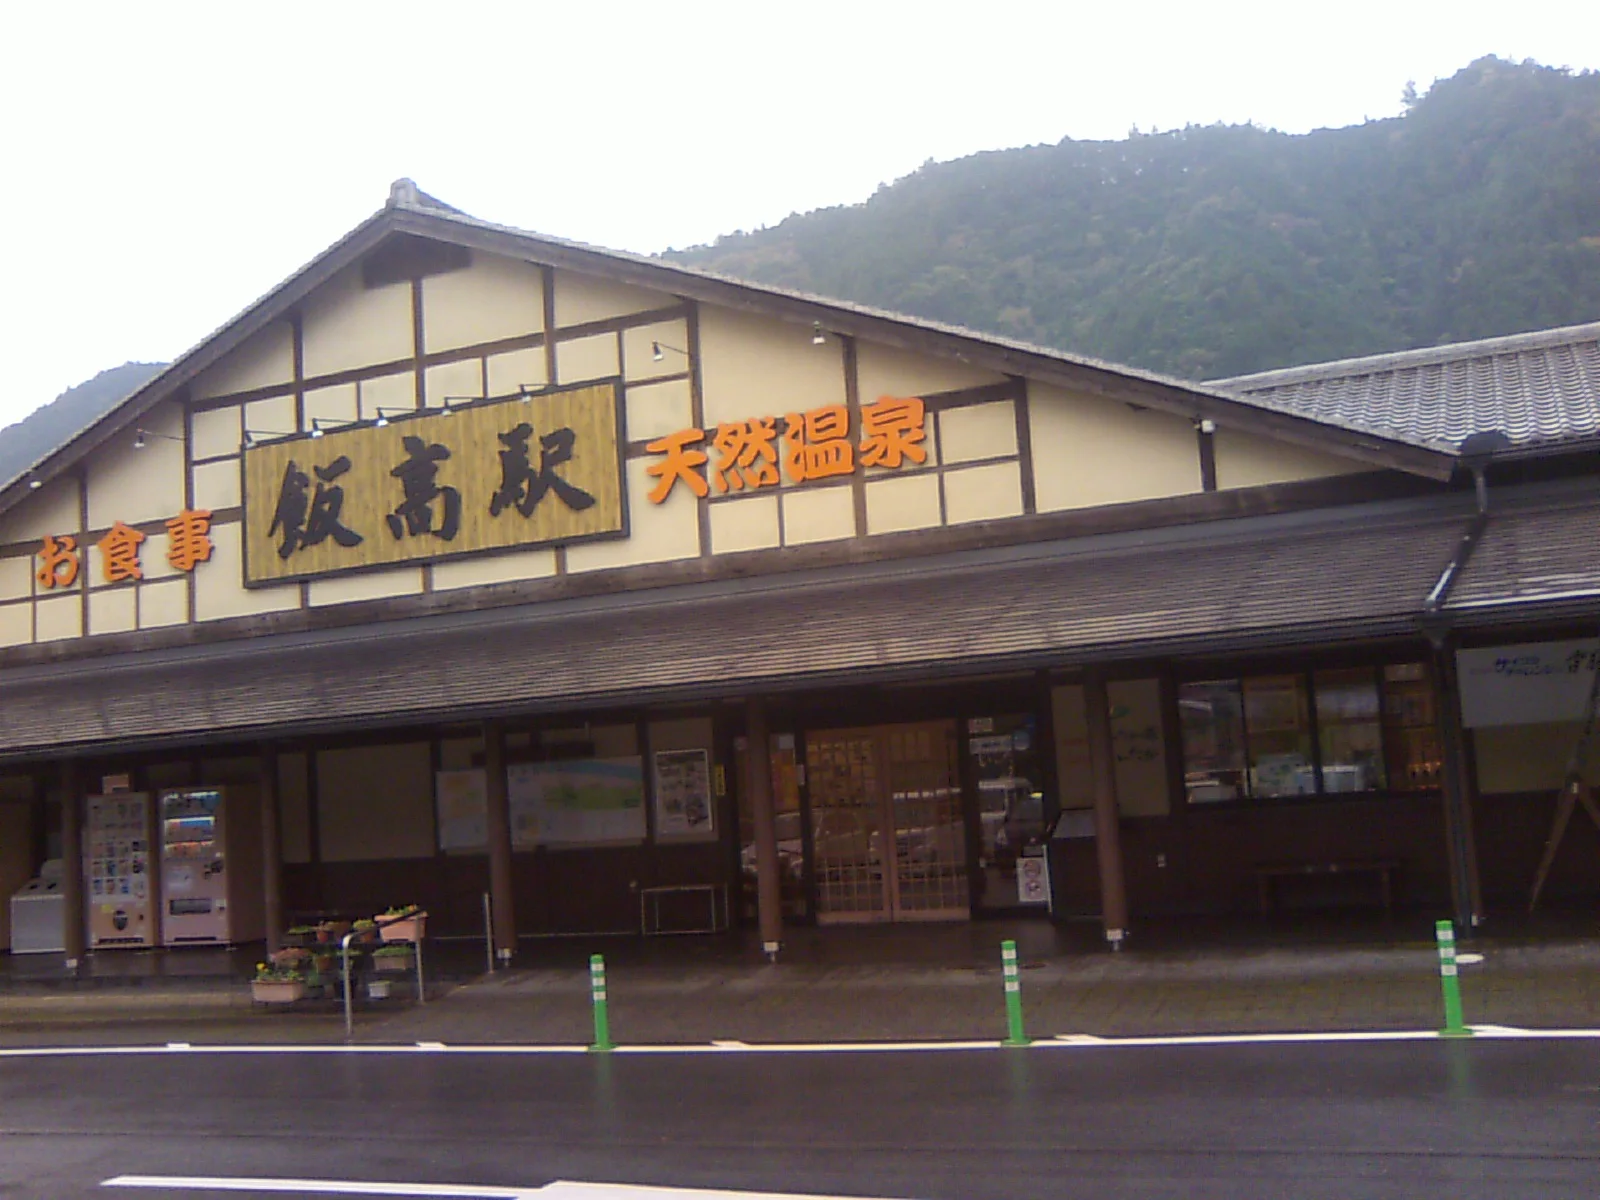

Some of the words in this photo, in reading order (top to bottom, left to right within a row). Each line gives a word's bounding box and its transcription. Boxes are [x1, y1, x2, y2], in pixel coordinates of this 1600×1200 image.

[267, 422, 596, 560] 飯高駅
[646, 395, 928, 505] 天然温泉
[36, 510, 211, 588] お食事
